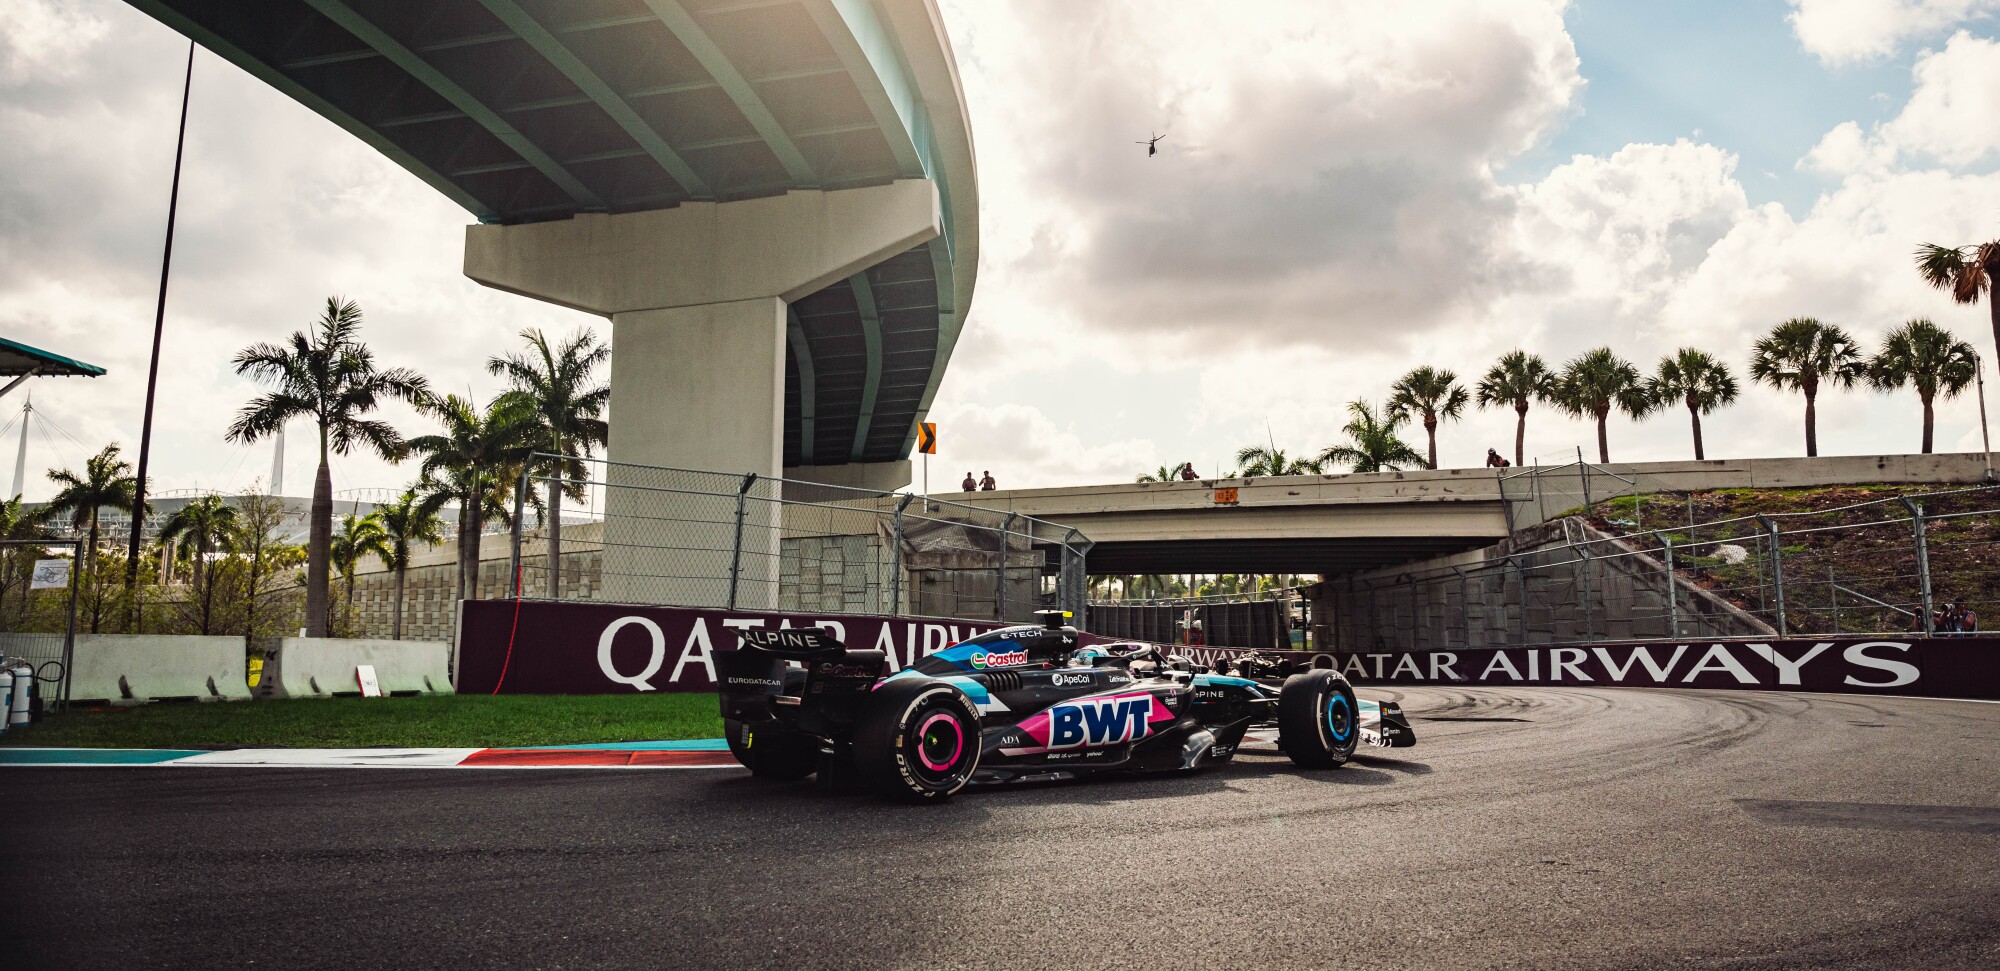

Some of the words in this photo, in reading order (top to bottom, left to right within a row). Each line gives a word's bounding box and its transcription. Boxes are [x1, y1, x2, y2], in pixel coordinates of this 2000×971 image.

[745, 631, 821, 648] ALPINE
[1000, 630, 1042, 640] E-TECH
[597, 616, 846, 691] QAT
[986, 649, 1029, 667] Castrol
[1310, 652, 1462, 680] QATAR
[1479, 641, 1921, 688] AIRWAYS
[728, 676, 781, 686] EURODATACAR
[1195, 690, 1224, 698] PINE
[1050, 697, 1151, 748] BWT
[1000, 735, 1020, 744] ADA
[896, 753, 925, 793] ZERO
